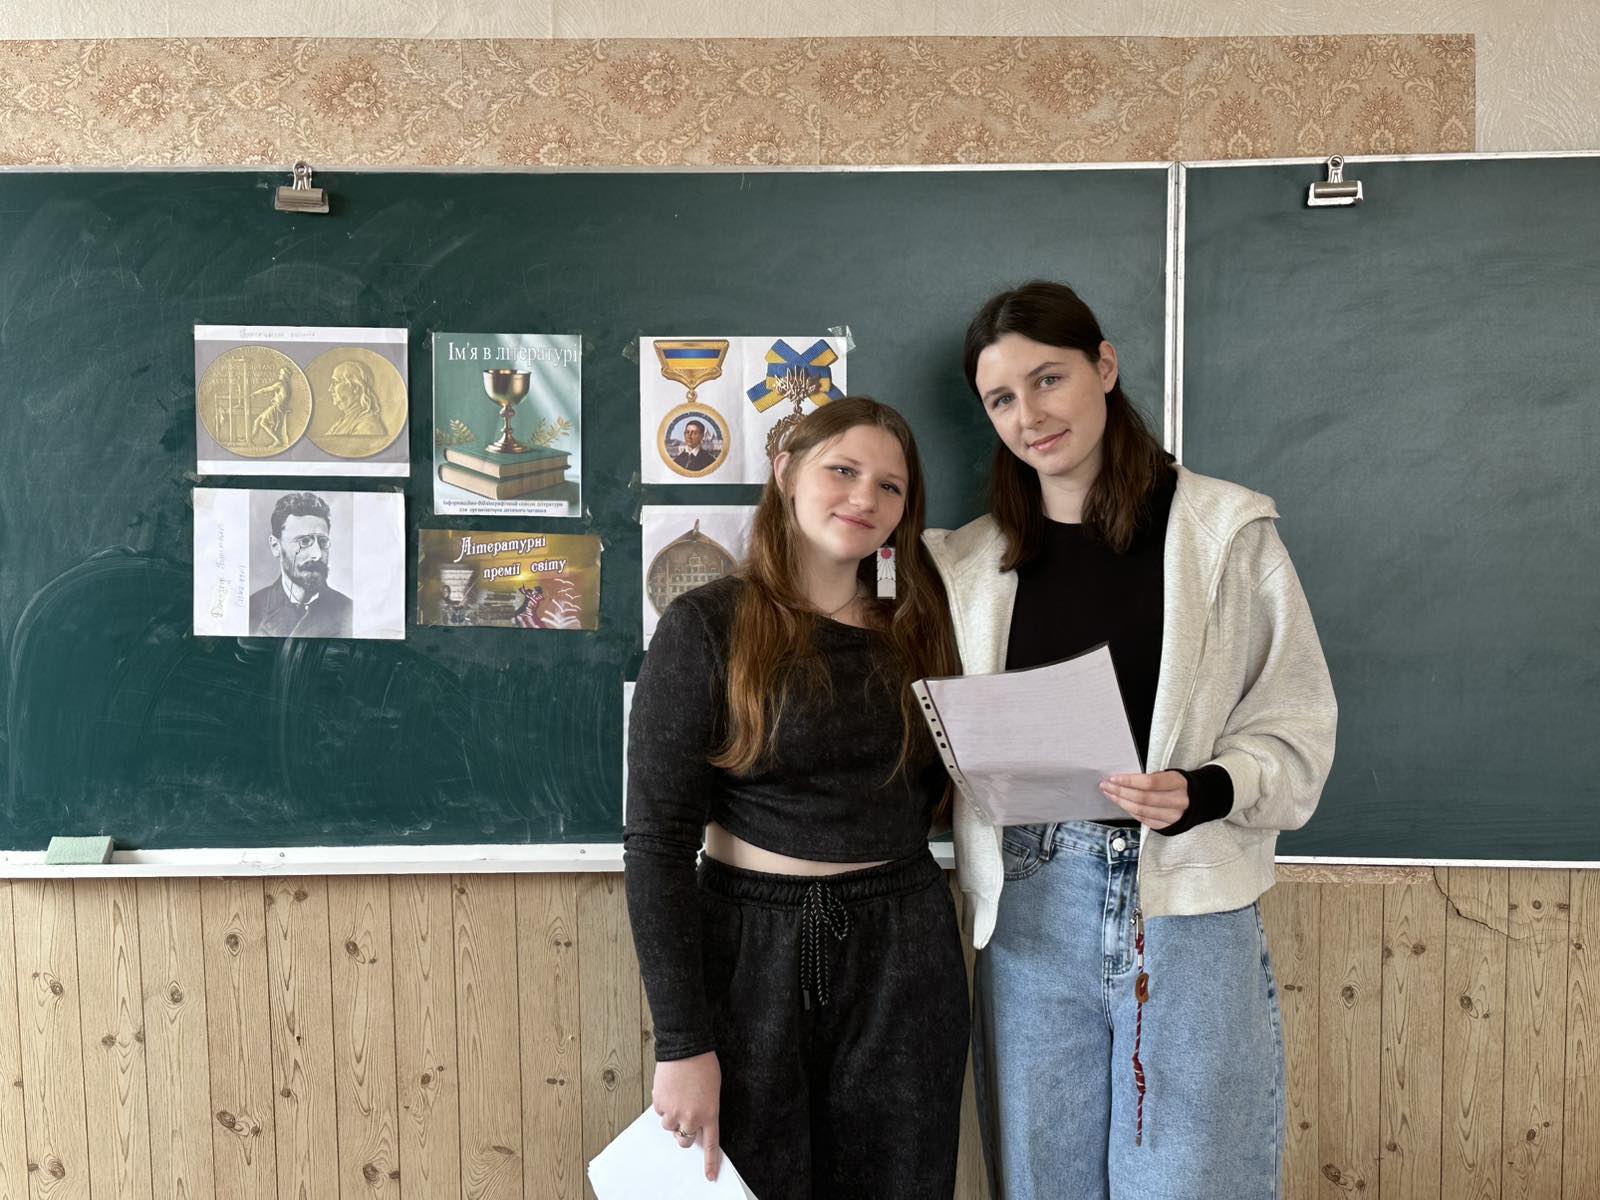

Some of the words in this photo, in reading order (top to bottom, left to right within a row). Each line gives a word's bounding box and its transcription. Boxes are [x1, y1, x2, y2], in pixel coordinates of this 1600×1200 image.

[448, 342, 478, 361] Ім'я
[483, 347, 492, 361] в
[496, 343, 578, 367] літературі
[453, 535, 547, 563] Літературні
[483, 562, 521, 581] премії
[531, 559, 567, 573] світу
